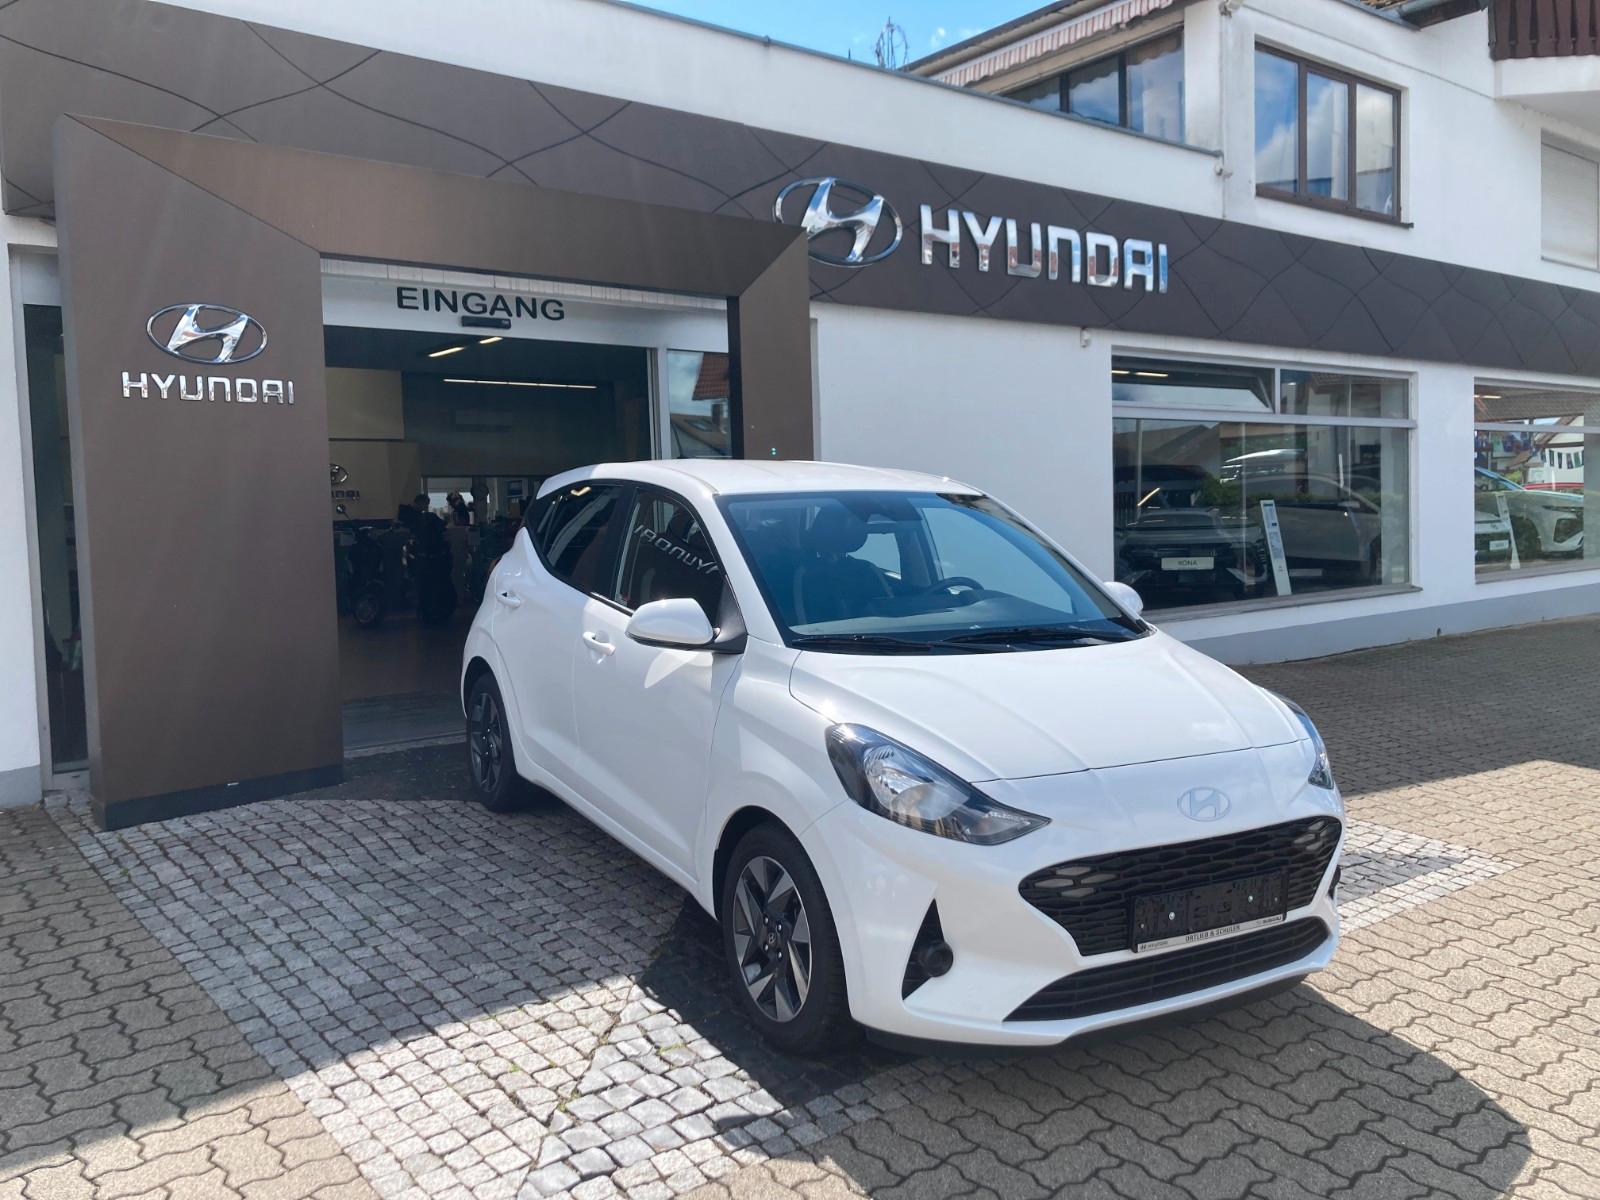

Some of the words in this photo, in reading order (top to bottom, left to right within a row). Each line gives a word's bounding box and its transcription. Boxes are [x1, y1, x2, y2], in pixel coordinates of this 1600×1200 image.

[920, 204, 1168, 293] HYUNDAI
[396, 286, 565, 321] EINGANG
[121, 371, 295, 405] HYUNDAI
